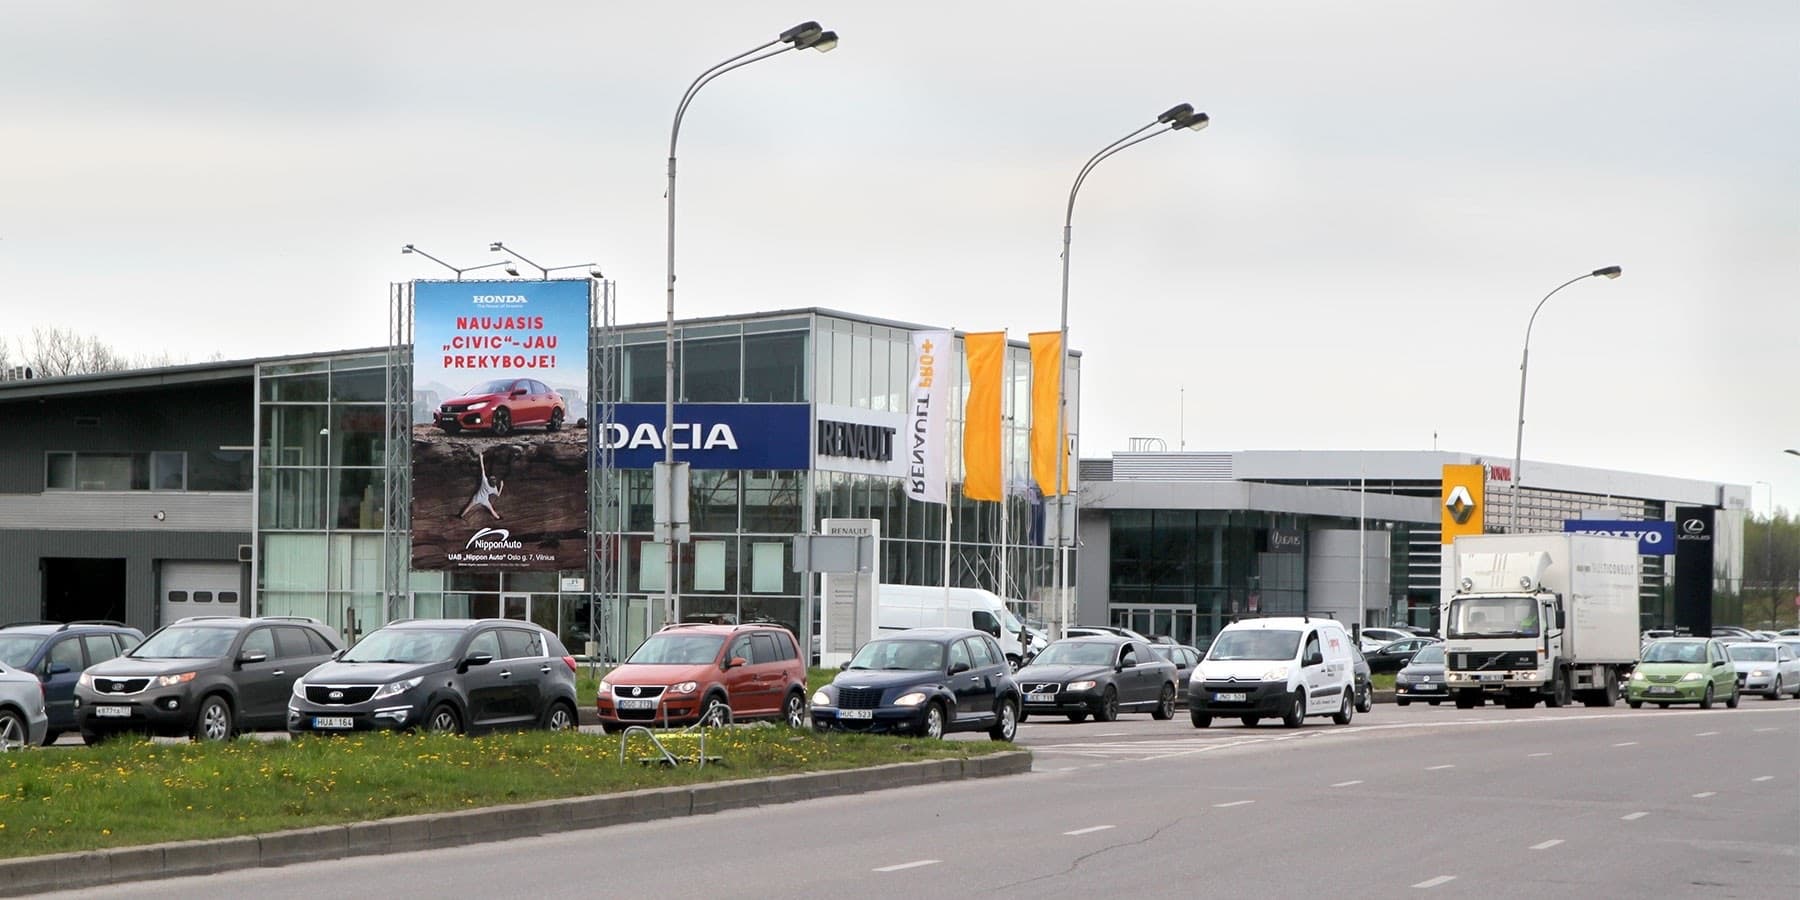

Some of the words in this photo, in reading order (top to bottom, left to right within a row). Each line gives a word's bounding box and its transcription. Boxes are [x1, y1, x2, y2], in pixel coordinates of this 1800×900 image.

[473, 295, 528, 304] HONDA
[456, 316, 544, 330] NAUJASIS
[444, 355, 556, 368] PREKYBOJE!
[597, 423, 739, 450] DACIA
[818, 419, 896, 462] RENAULT
[831, 527, 868, 536] RENAULT
[1678, 533, 1711, 541] LEXUS
[475, 540, 522, 551] NipponAuto
[840, 710, 854, 718] HUC
[318, 718, 333, 727] HUA
[339, 718, 353, 727] 164
